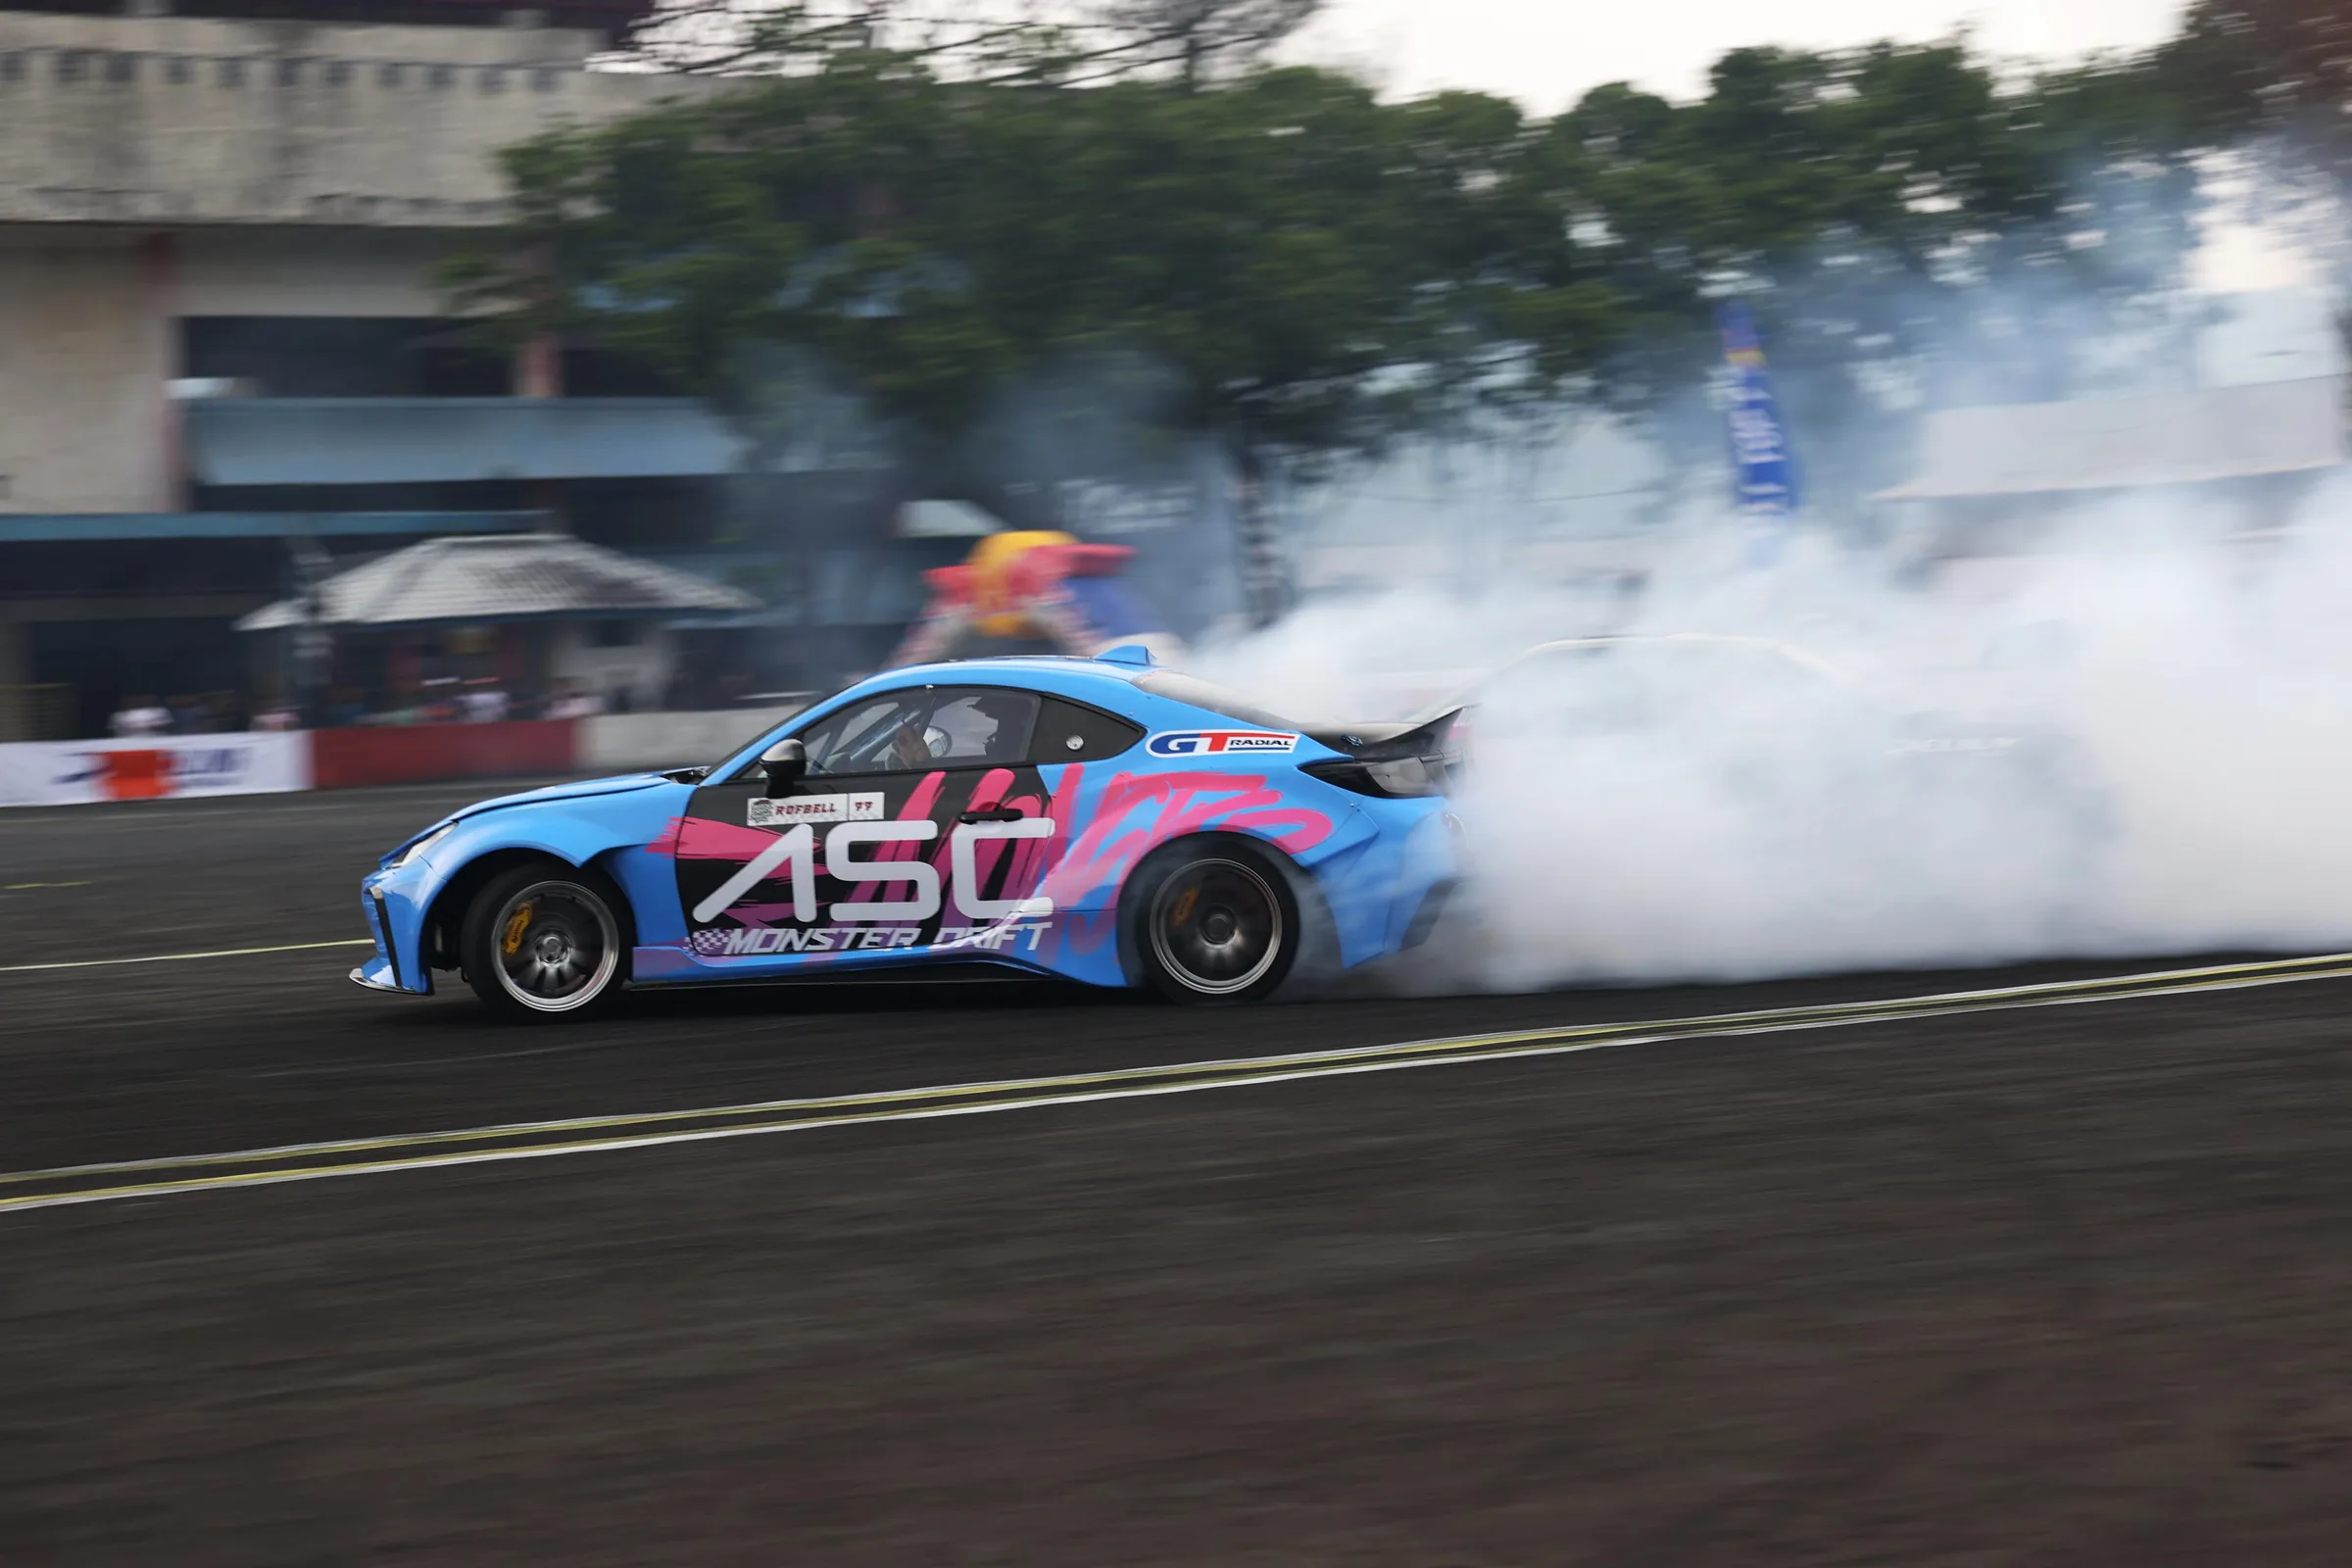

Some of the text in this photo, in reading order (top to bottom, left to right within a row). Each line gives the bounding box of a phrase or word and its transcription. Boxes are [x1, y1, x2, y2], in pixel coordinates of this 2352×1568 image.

[1151, 732, 1233, 754] GT
[692, 817, 1055, 922] ASC
[724, 922, 1052, 956] MONSTER DRIFT
